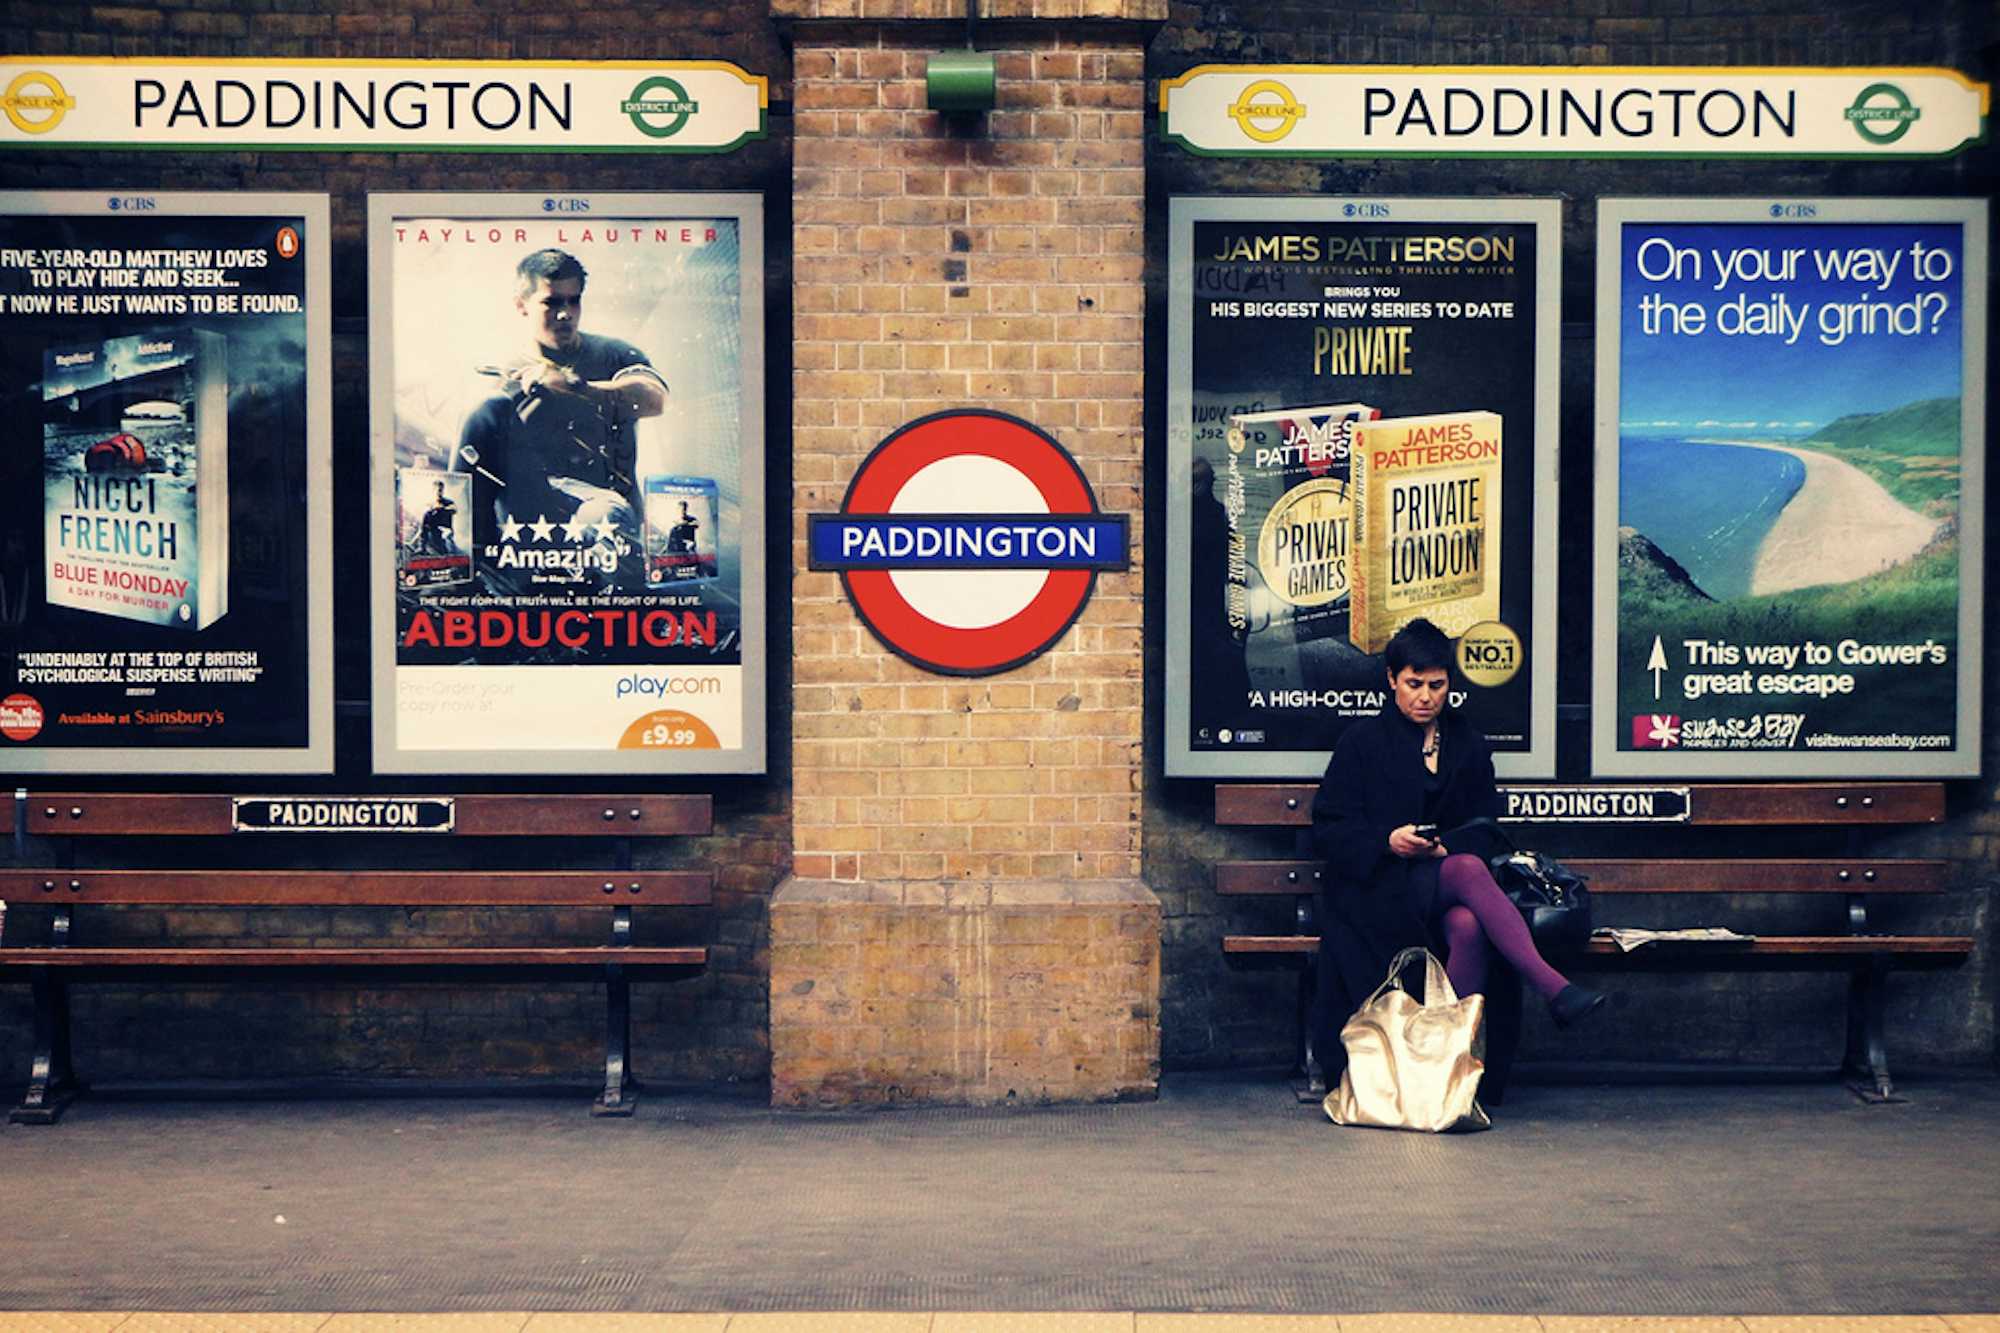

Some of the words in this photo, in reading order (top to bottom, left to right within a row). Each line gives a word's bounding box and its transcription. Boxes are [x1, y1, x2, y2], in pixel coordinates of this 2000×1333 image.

[135, 80, 570, 130] PADDINGTON
[625, 103, 668, 113] DISTRICT
[673, 103, 693, 113] LINE
[1364, 88, 1795, 138] PADDINGTON
[1848, 109, 1890, 119] DISTRICT
[1895, 110, 1916, 120] LINE
[123, 198, 155, 210] CBS
[559, 199, 590, 212] CBS
[1358, 203, 1390, 217] CBS
[1785, 203, 1816, 217] CBS
[397, 229, 527, 243] TAYLOR
[559, 229, 718, 243] LAUTNER
[1, 249, 122, 267] FIVE-YEAR-OLD
[126, 249, 212, 267] MATTHEW
[216, 249, 268, 267] LOVES
[1214, 236, 1320, 262] JAMES
[1328, 236, 1514, 262] PATTERSON
[1636, 238, 1701, 281] On
[1712, 248, 1805, 290] your
[1814, 248, 1902, 290] way
[1910, 240, 1952, 281] to
[30, 269, 52, 287] TO
[56, 269, 97, 287] PLAY
[100, 269, 139, 287] HIDE
[142, 269, 178, 287] AND
[182, 269, 240, 288] SEEK...
[1324, 287, 1371, 297] BRINGS
[1373, 287, 1401, 297] YOU
[11, 294, 52, 313] NOW
[56, 294, 79, 313] HE
[81, 294, 122, 314] JUST
[124, 294, 187, 314] WANTS
[190, 294, 213, 313] TO
[216, 294, 238, 313] BE
[242, 294, 303, 313] FOUND.
[1211, 303, 1240, 317] HIS
[1244, 303, 1320, 317] BIGGEST
[1324, 303, 1367, 317] NEW
[1371, 303, 1432, 318] SERIES
[1435, 303, 1461, 318] TO
[1465, 303, 1514, 318] DATE
[1639, 293, 1706, 335] the
[1717, 293, 1809, 344] daily
[1819, 292, 1948, 346] grind?
[1313, 327, 1413, 376] PRIVATE
[1284, 420, 1352, 446] JAMES
[1402, 424, 1473, 447] JAMES
[1255, 440, 1349, 468] PATTERS
[1374, 440, 1498, 470] PATTERSON
[74, 475, 156, 515] NICCI
[1392, 478, 1480, 533] PRIVATE
[60, 515, 176, 560] FRENCH
[842, 527, 1096, 557] PADDINGTON
[1274, 518, 1349, 568] PRIVAT
[1391, 528, 1479, 585] LONDON
[54, 563, 97, 584] BLUE
[104, 570, 189, 598] MONDAY
[1288, 560, 1346, 598] GAMES
[77, 588, 95, 597] DAY
[99, 591, 119, 601] FOR
[122, 595, 169, 610] MURDER
[420, 596, 438, 606] THE
[440, 596, 469, 606] FIGHT
[516, 596, 548, 606] TRUTH
[551, 596, 573, 606] WILL
[575, 596, 589, 606] BE
[591, 596, 609, 606] THE
[612, 596, 642, 606] FIGHT
[644, 596, 657, 606] OF
[660, 596, 676, 606] HIS
[403, 611, 717, 647] ABDUCTION
[109, 653, 126, 667] AT
[128, 653, 154, 667] THE
[156, 653, 182, 667] TOP
[185, 653, 203, 667] OF
[205, 652, 257, 667] BRITISH
[1465, 646, 1513, 662] NO.1
[1683, 640, 1740, 665] This
[1744, 645, 1800, 669] way
[1805, 641, 1832, 665] to
[1838, 639, 1947, 665] Gower's
[18, 668, 124, 683] PSYCHOLOGICAL
[126, 668, 196, 682] SUSPENSE
[617, 673, 721, 698] play.com
[1683, 672, 1753, 698] great
[1757, 674, 1855, 698] escape
[1270, 691, 1386, 707] HIGH-OCTAN
[58, 712, 116, 725] Available
[118, 714, 131, 725] at
[134, 709, 225, 727] Sainsbury's
[643, 724, 696, 745] £9.99
[1805, 734, 1950, 750] visitswanseabay.com
[269, 804, 417, 825] PADDINGTON
[1508, 794, 1653, 816] PADDINGTON
